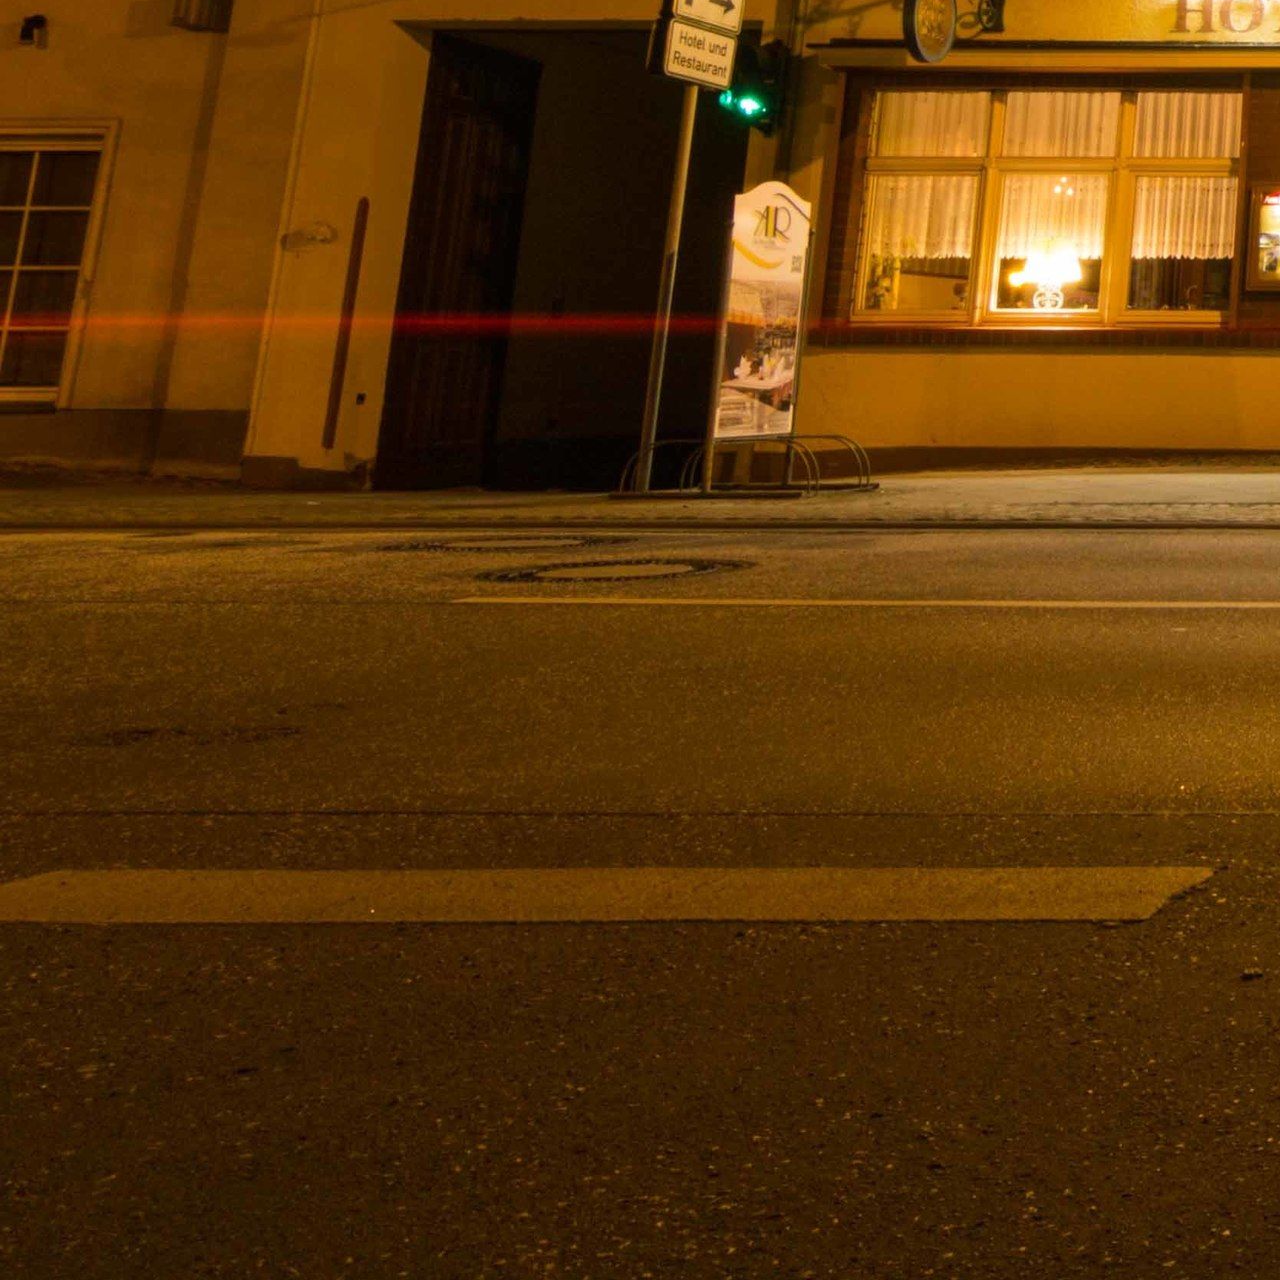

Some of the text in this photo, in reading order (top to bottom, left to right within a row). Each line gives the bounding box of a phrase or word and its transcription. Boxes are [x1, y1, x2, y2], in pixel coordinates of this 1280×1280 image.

[679, 31, 728, 57] Hotel und
[672, 51, 727, 78] Restaurant
